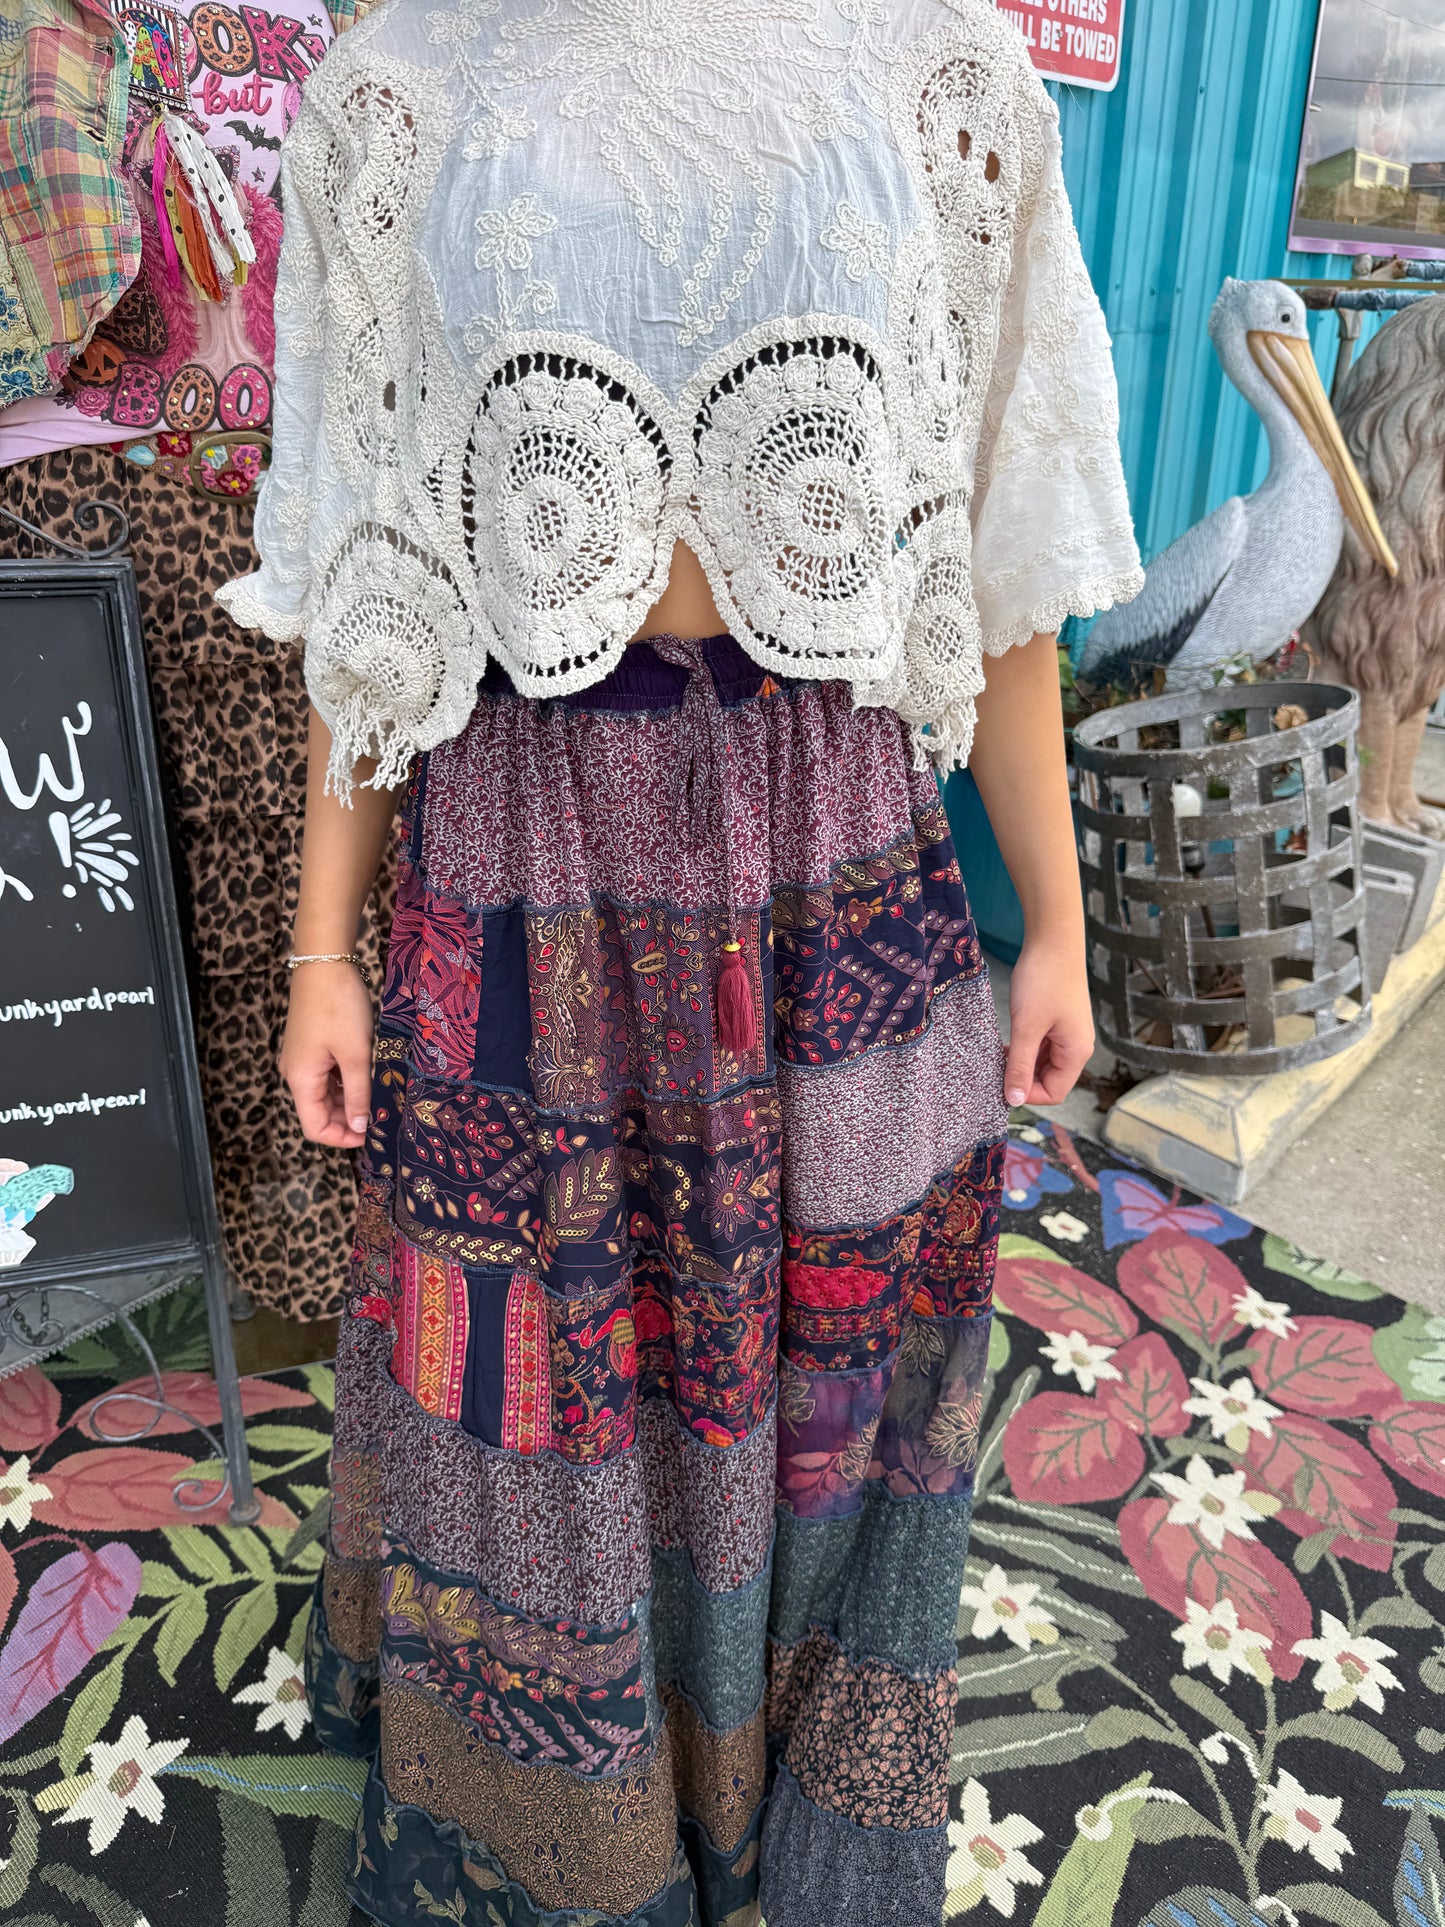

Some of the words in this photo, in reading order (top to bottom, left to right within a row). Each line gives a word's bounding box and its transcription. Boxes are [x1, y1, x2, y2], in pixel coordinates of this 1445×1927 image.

[1040, 18, 1062, 52] BE
[1065, 24, 1116, 64] TOWED
[192, 71, 273, 116] but
[109, 362, 274, 432] BOO
